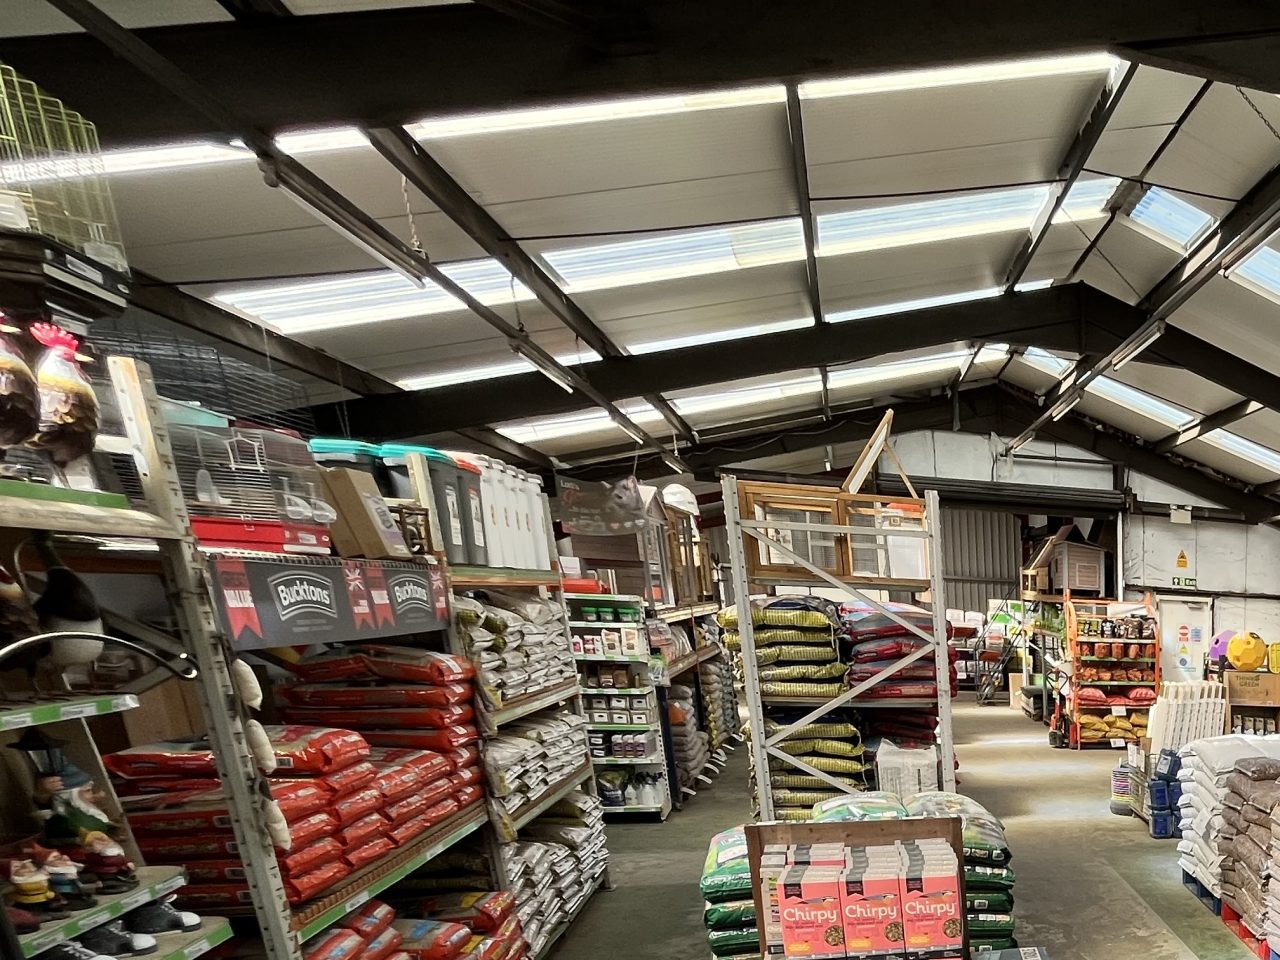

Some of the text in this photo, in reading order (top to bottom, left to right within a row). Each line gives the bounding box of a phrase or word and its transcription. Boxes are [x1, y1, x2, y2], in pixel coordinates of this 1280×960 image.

[277, 580, 330, 606] Bucktons
[394, 581, 427, 602] Bucktons
[783, 907, 837, 924] Chirpy
[845, 903, 898, 922] Chirpy
[905, 899, 956, 919] Chirpy
